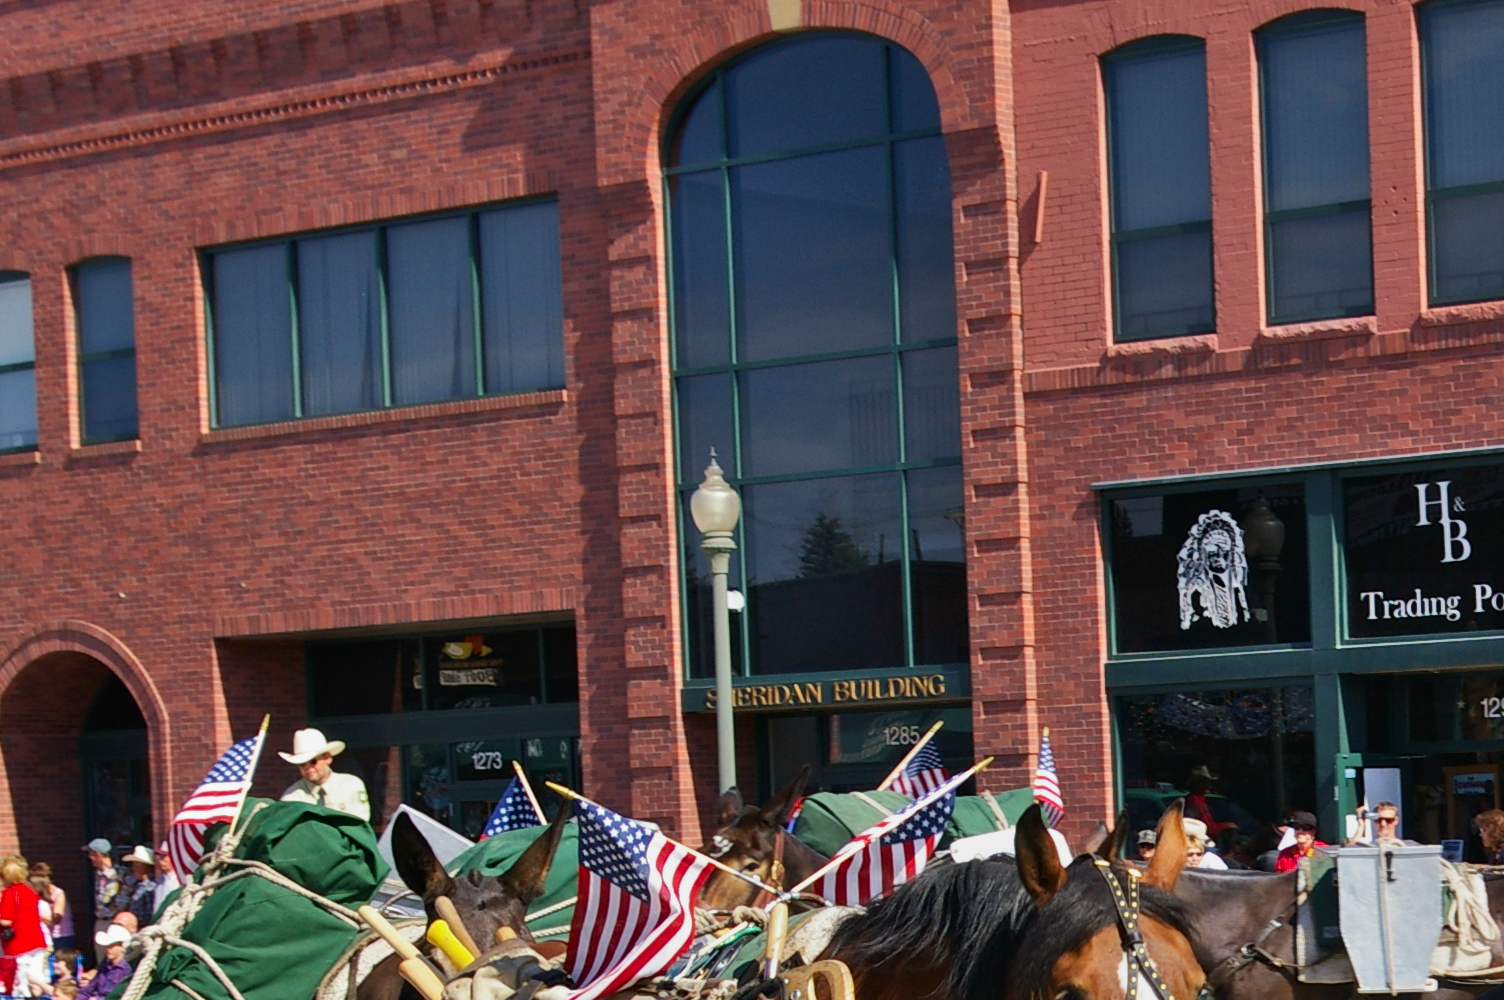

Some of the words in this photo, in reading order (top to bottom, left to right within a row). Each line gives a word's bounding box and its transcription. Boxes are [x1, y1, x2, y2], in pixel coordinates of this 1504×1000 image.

[1360, 588, 1462, 622] Trading
[833, 674, 946, 702] BUILDING
[882, 726, 921, 746] 1285
[472, 751, 503, 770] 1273
